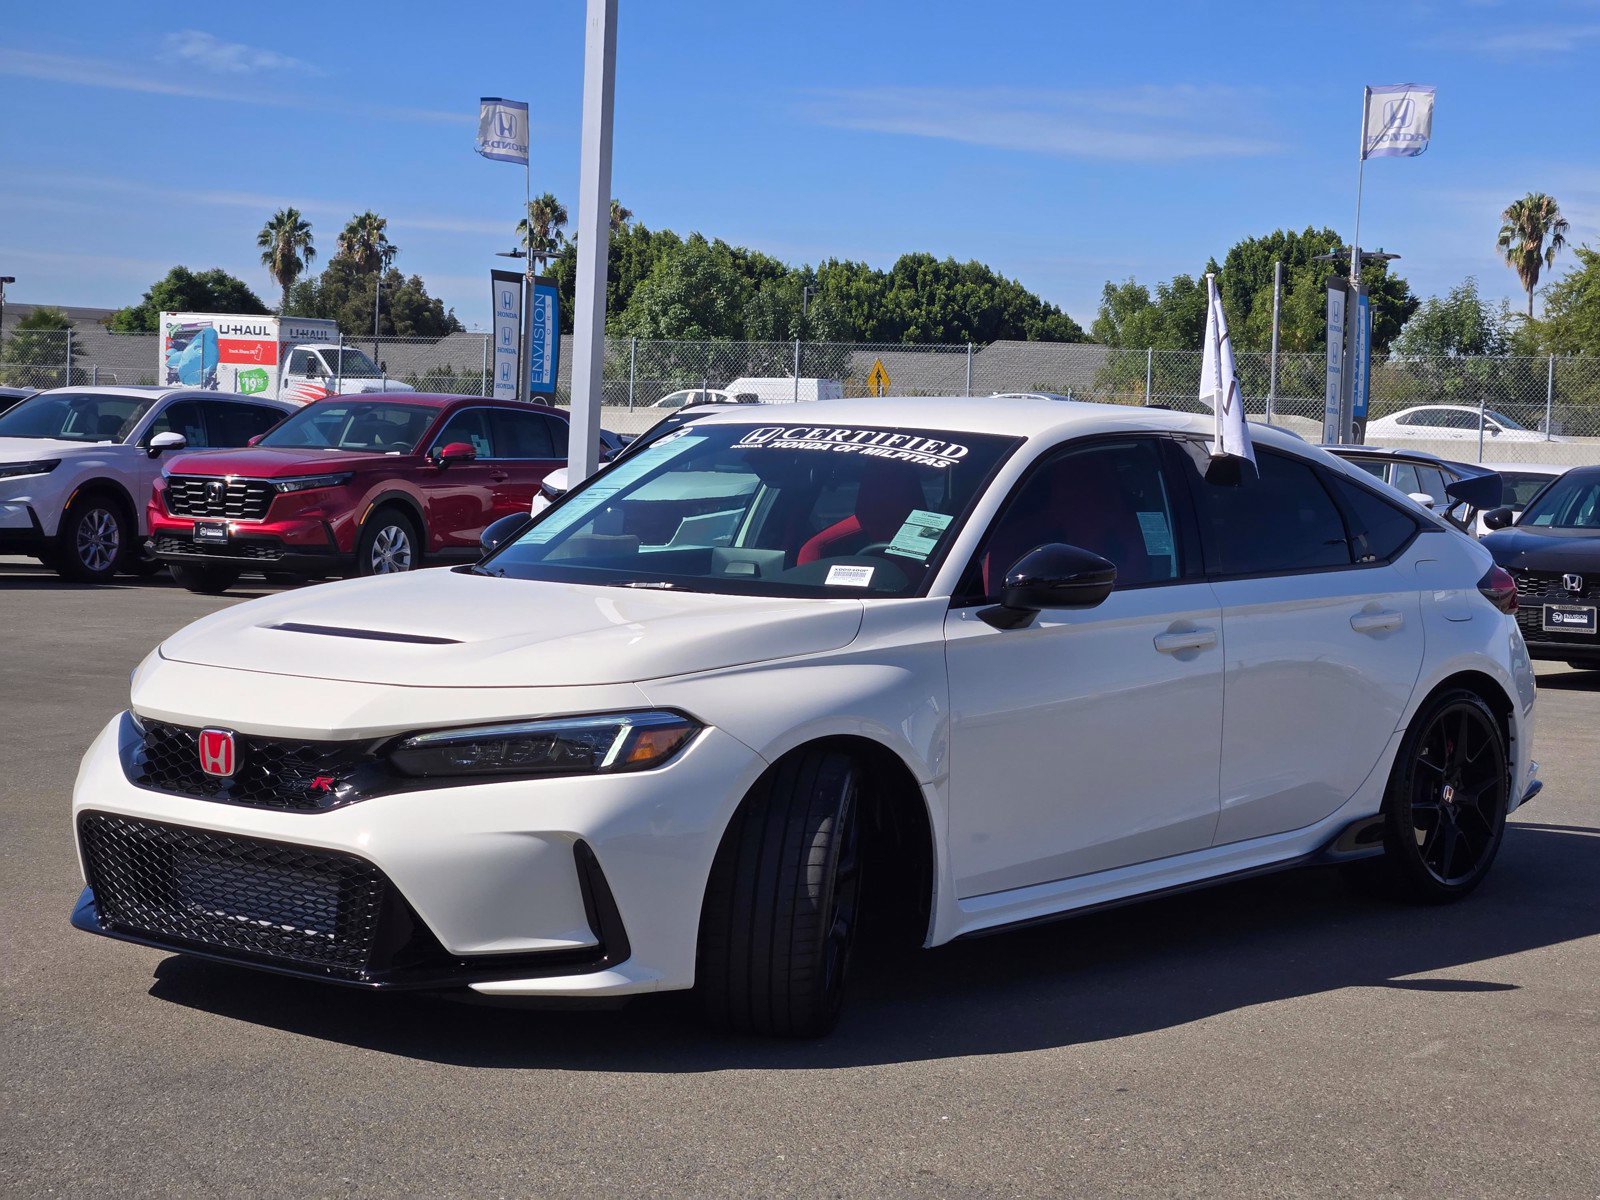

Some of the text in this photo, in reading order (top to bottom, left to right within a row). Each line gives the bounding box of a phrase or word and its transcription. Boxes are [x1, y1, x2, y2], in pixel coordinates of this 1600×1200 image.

[496, 311, 518, 319] HONDA
[219, 325, 271, 336] U-HAUL
[290, 329, 330, 340] U-HAUL
[531, 293, 545, 383] ENVISION
[496, 347, 517, 355] HONDA
[782, 427, 969, 458] CERTIFIED
[766, 441, 951, 468] HONDA OF MILPITAS
[310, 776, 335, 791] R
